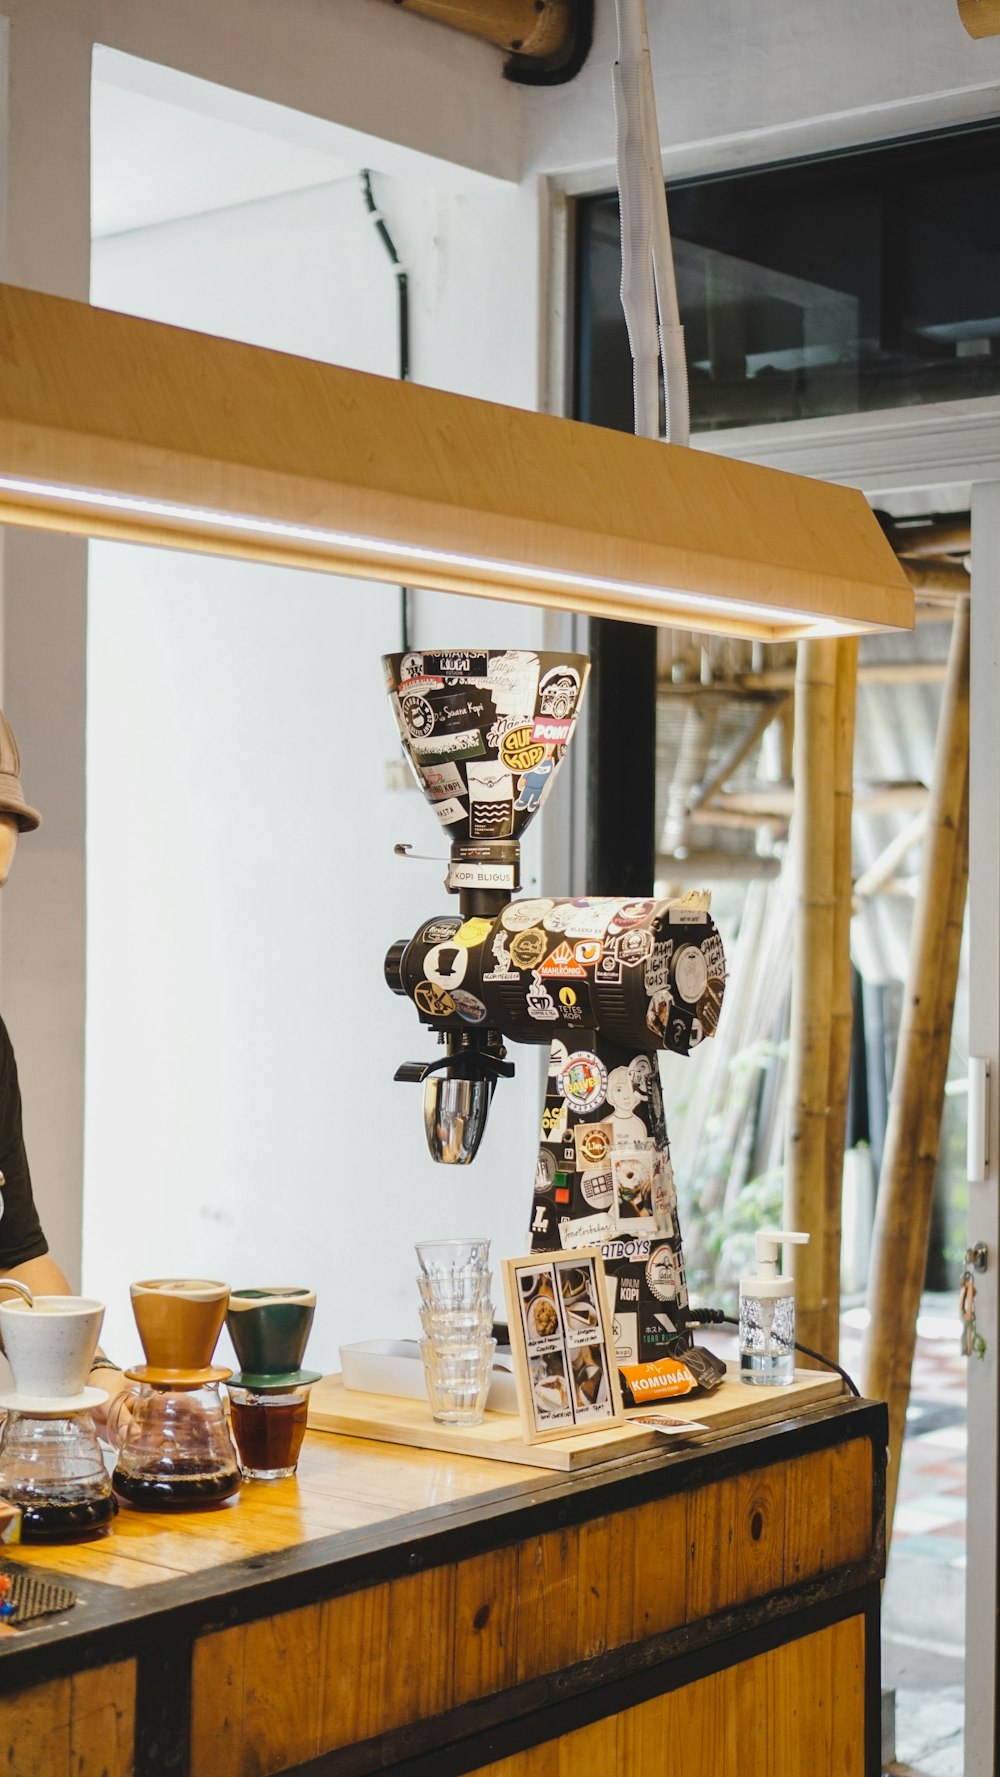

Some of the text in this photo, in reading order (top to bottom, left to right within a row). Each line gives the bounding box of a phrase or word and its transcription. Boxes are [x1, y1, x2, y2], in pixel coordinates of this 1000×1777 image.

[440, 659, 470, 671] KOPI
[443, 701, 484, 719] Suara Kopi
[445, 781, 461, 792] KOPI
[455, 872, 511, 881] KOPI BLIGUS
[541, 964, 581, 975] MAHLKÖNIG
[558, 1005, 582, 1014] TETES
[563, 1012, 582, 1020] KOPI
[602, 1240, 650, 1258] ATBOYS
[621, 1278, 640, 1288] MINUM
[620, 1287, 640, 1301] KOPI
[645, 1326, 663, 1334] ホスト
[631, 1368, 692, 1391] KOMUNÁL
